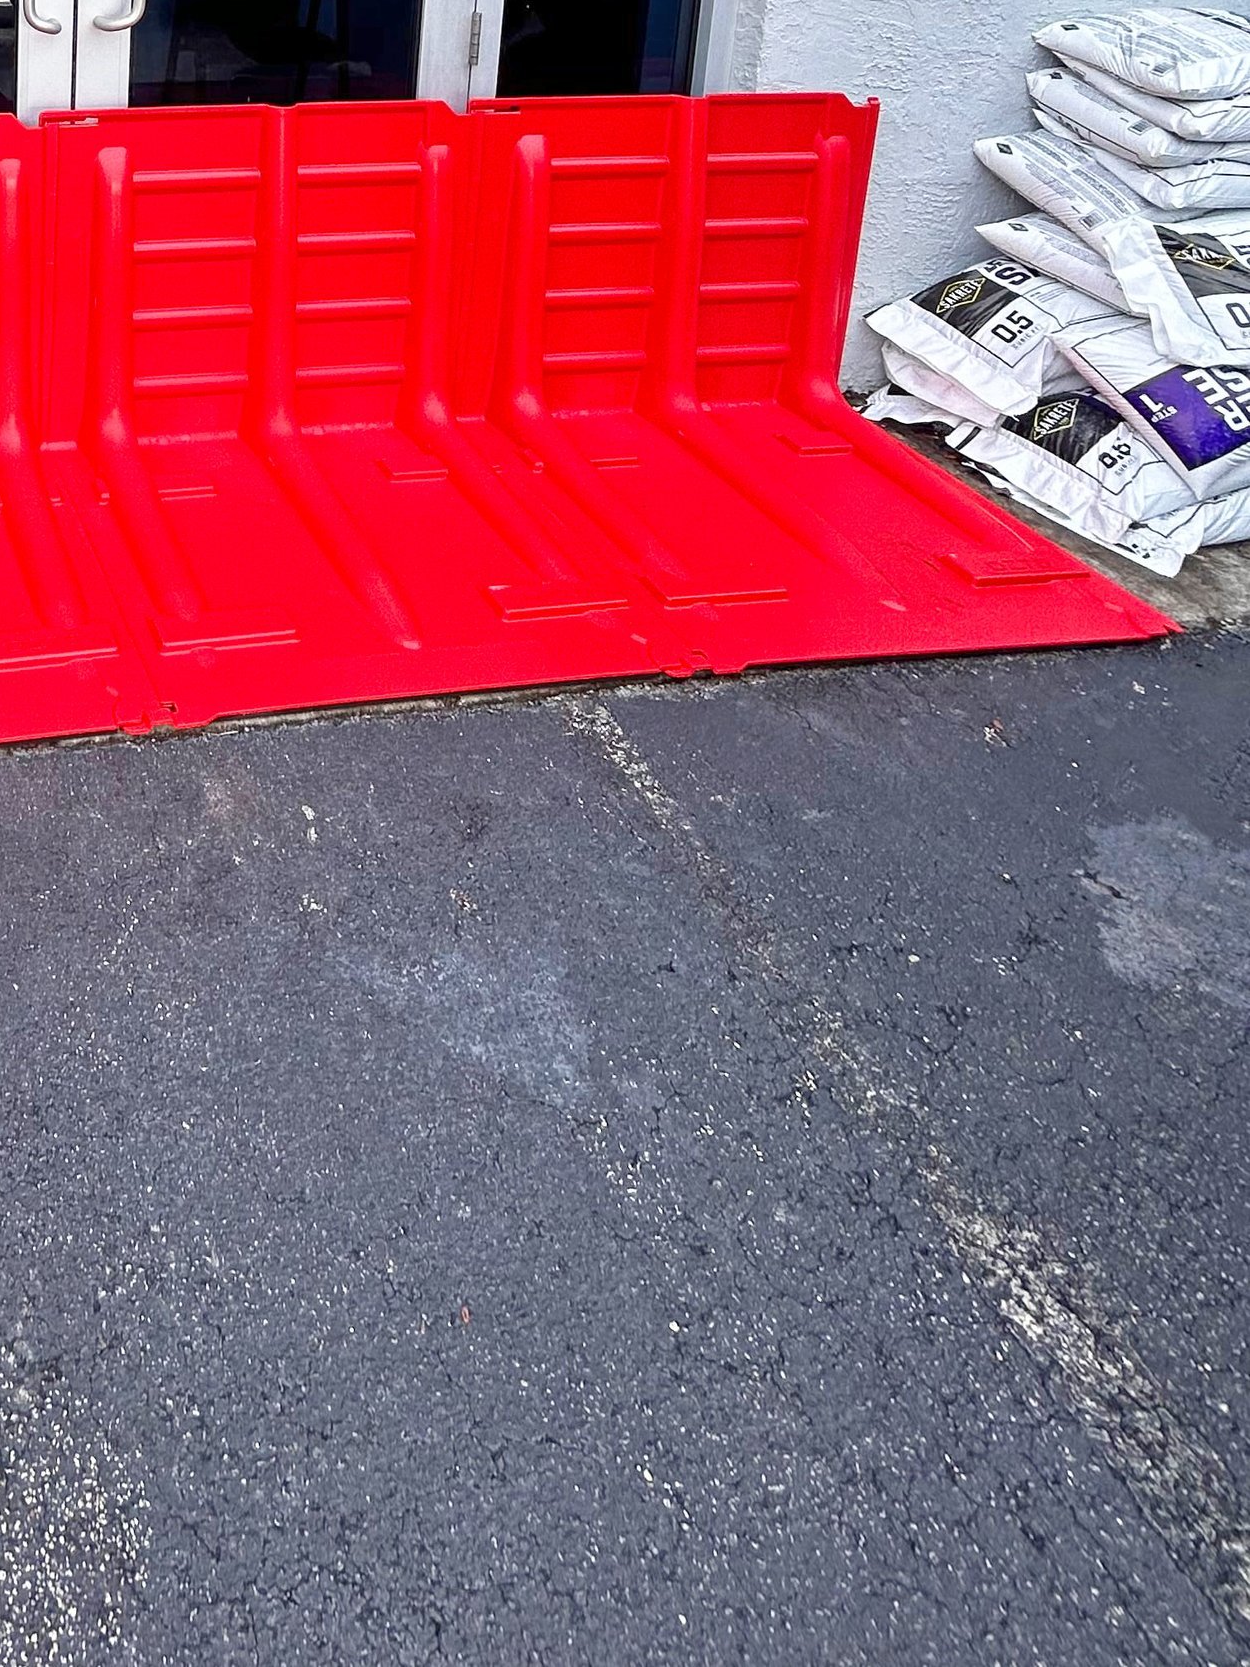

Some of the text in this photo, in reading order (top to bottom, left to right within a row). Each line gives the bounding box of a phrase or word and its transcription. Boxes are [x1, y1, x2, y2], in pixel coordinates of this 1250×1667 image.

[939, 277, 983, 310] SAKRETE
[991, 310, 1034, 344] 0.5
[1034, 399, 1077, 435] SAKRETE
[1138, 393, 1164, 413] 1
[1151, 405, 1178, 423] STEP
